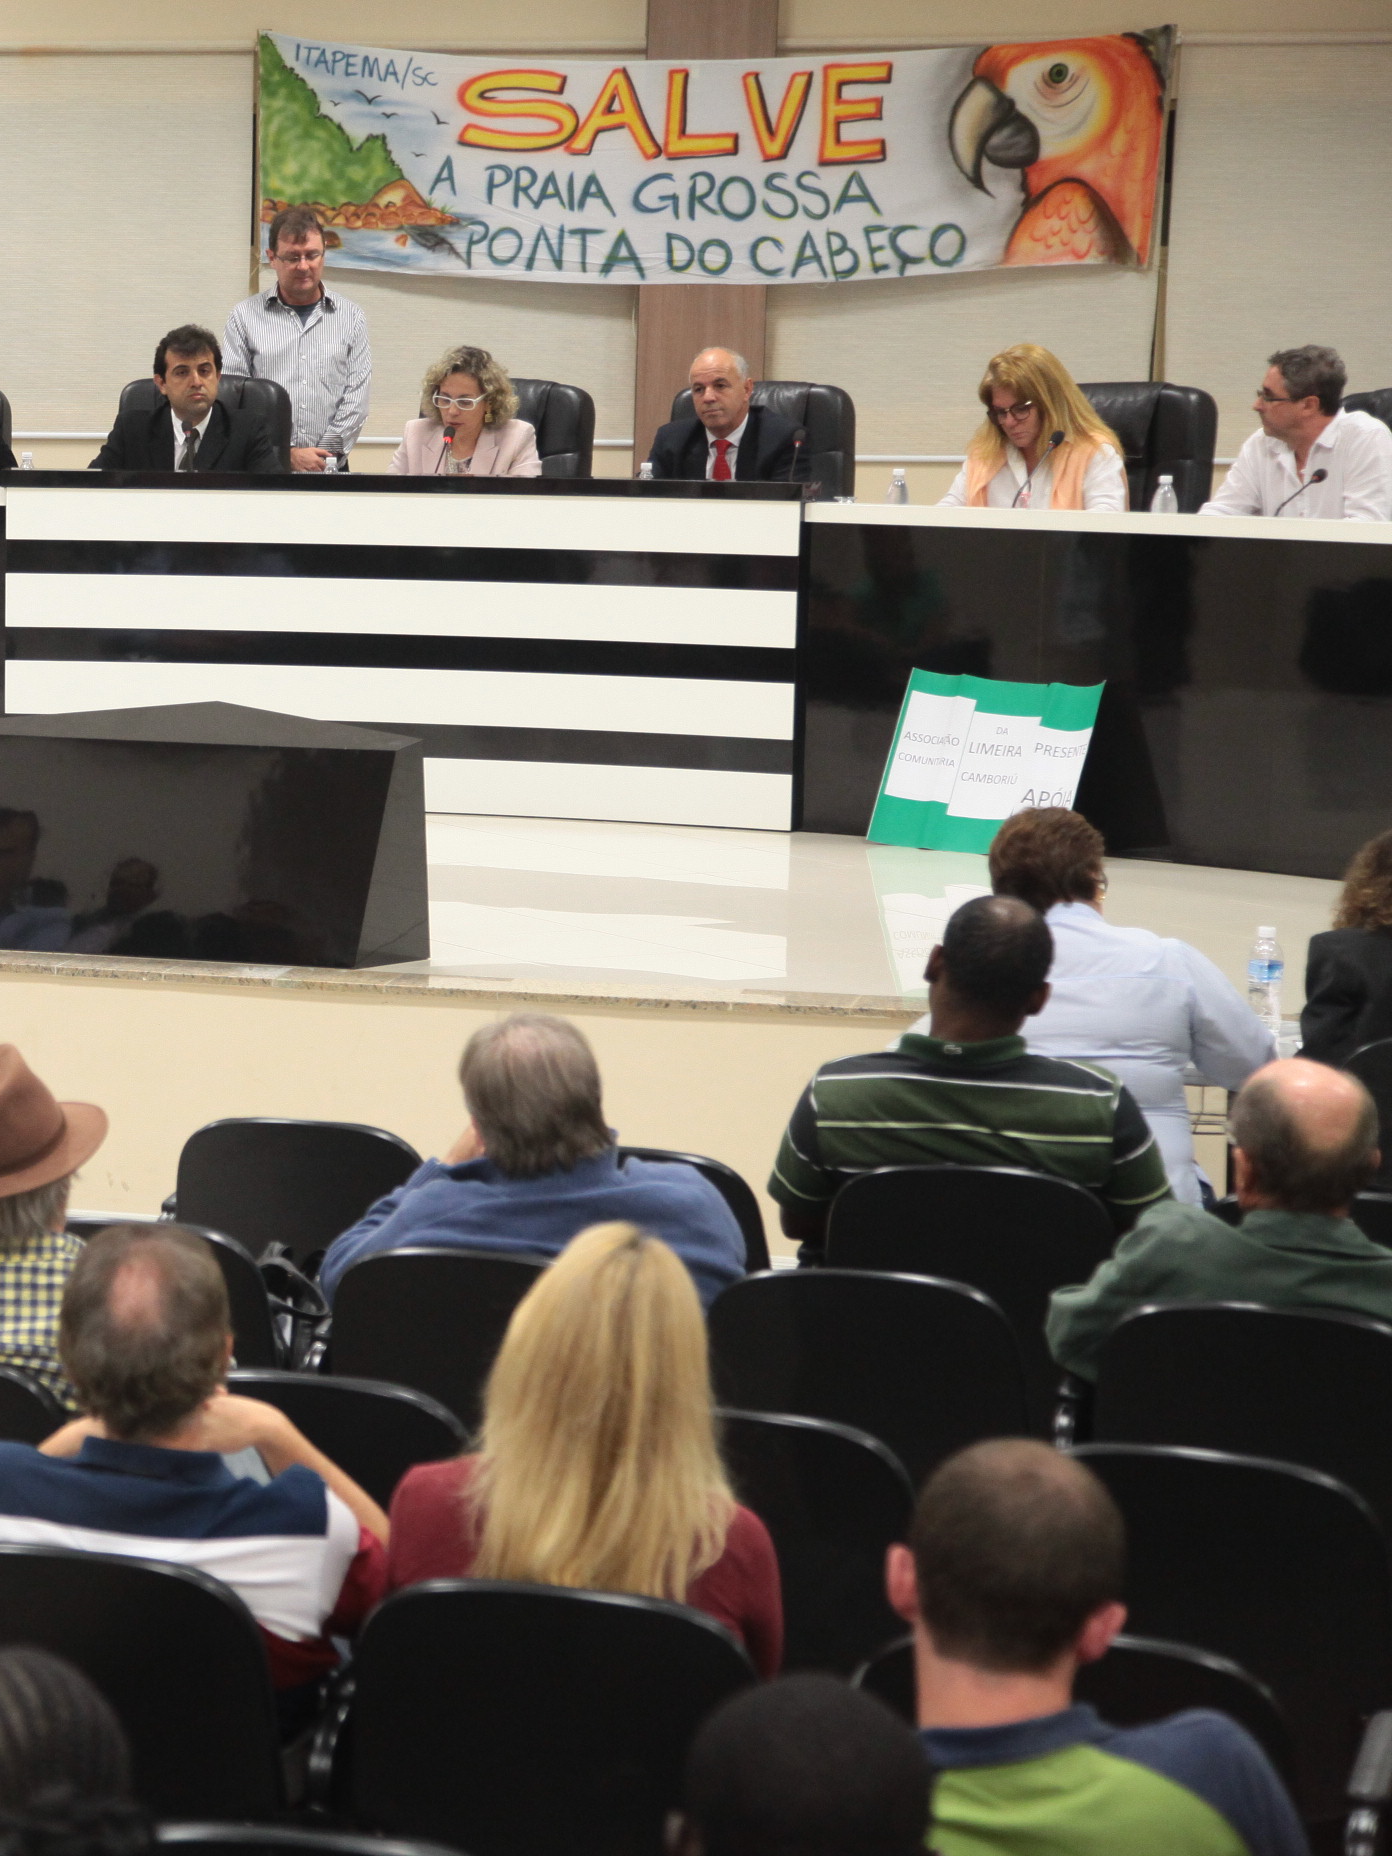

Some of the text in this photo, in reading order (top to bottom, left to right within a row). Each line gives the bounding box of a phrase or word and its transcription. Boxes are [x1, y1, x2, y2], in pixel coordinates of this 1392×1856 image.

[294, 42, 438, 90] ITAPEMA/SC
[456, 61, 893, 165] SALVE
[429, 155, 883, 222] A PRAIA GROSSA
[464, 220, 967, 281] PONTA DO CABEÇO
[968, 741, 1022, 758] LIMEIRA
[995, 726, 1009, 736] DA
[960, 771, 1019, 785] CAMBORIÚ
